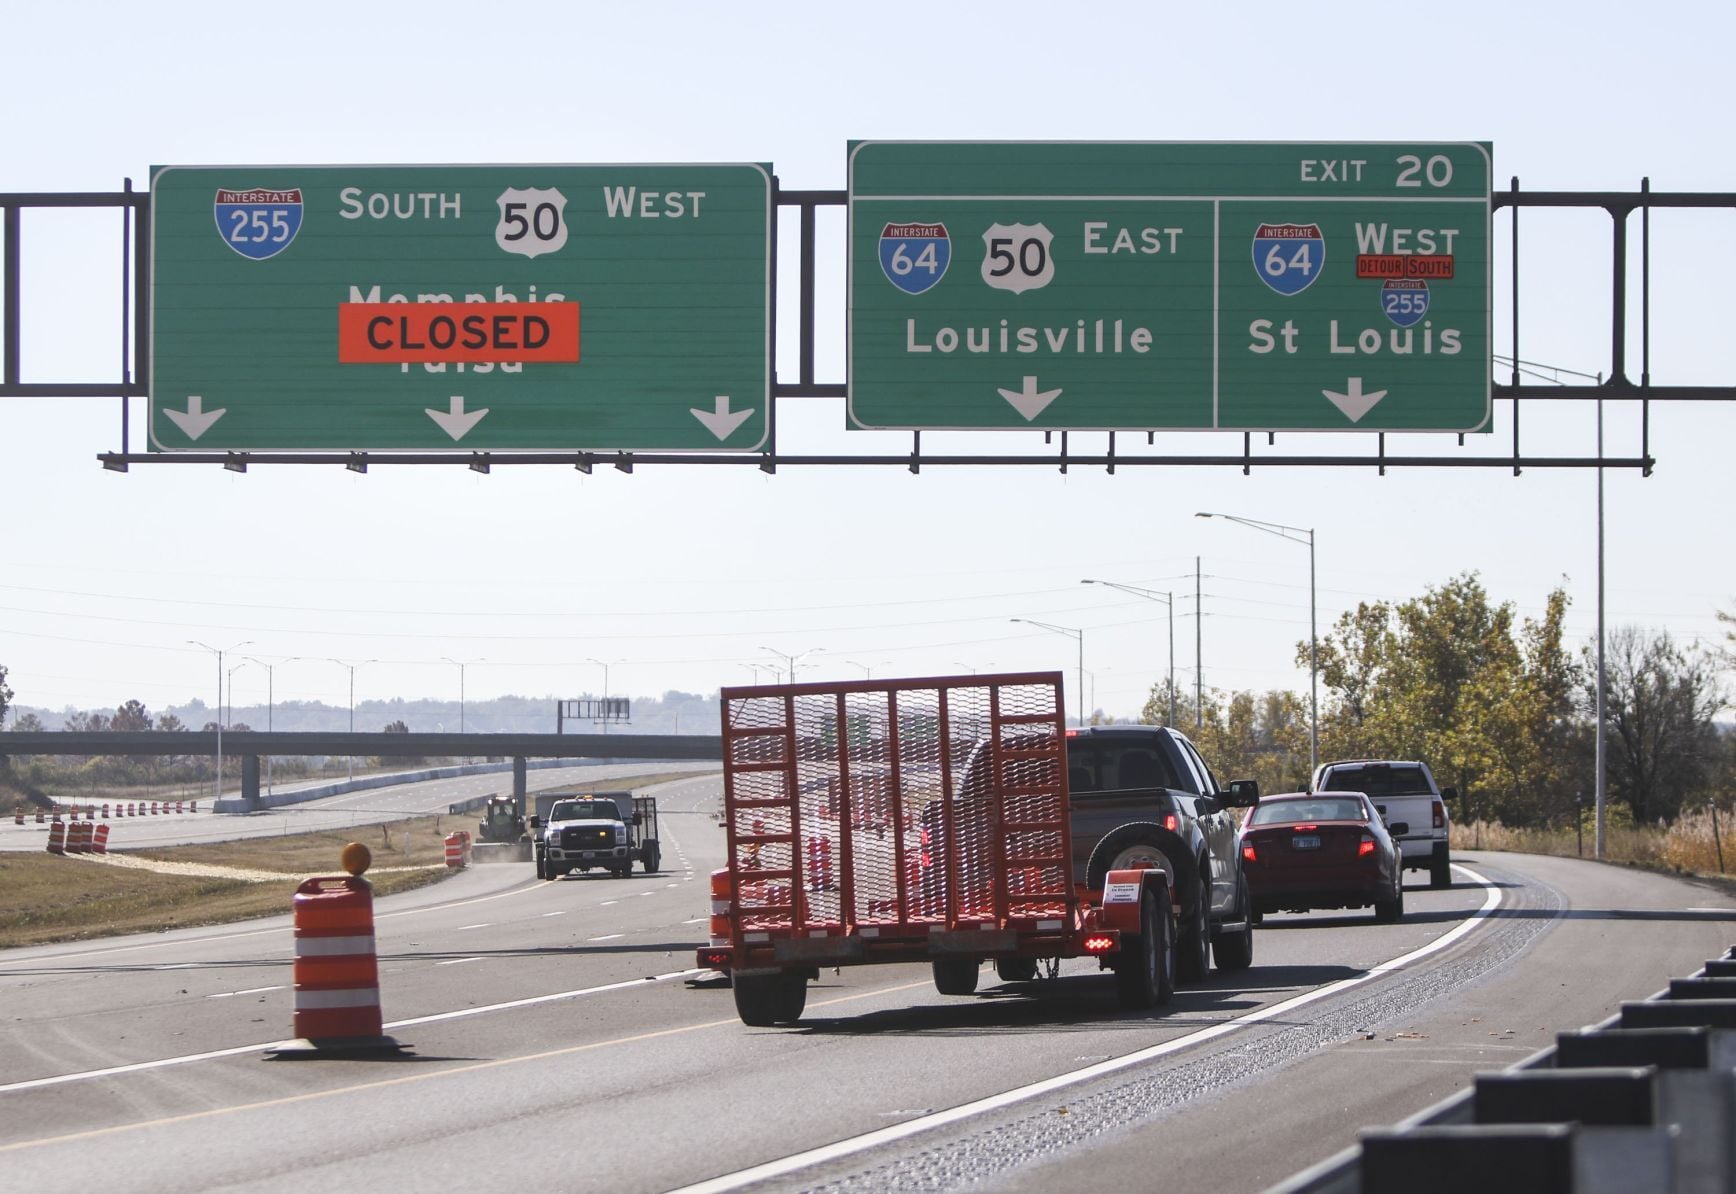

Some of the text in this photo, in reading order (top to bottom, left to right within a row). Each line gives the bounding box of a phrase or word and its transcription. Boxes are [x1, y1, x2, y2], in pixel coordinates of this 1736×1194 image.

[1301, 154, 1453, 188] EXIT 20
[223, 193, 295, 203] INTERSTATE
[338, 187, 461, 219] SOUTH
[603, 186, 706, 218] WEST
[230, 210, 289, 242] 255
[503, 202, 560, 241] 50
[890, 227, 938, 237] INTERSTATE
[1264, 228, 1313, 238] INTERSTATE
[1084, 222, 1183, 254] EAST
[1355, 222, 1459, 255] WEST
[891, 242, 938, 276] 64
[989, 237, 1046, 277] 50
[1264, 243, 1312, 276] 64
[1360, 259, 1451, 274] DETOUR SOUTH
[1386, 294, 1426, 314] 255
[367, 315, 550, 350] CLOSED
[907, 318, 1153, 353] Louisville
[1248, 318, 1462, 354] St Louis
